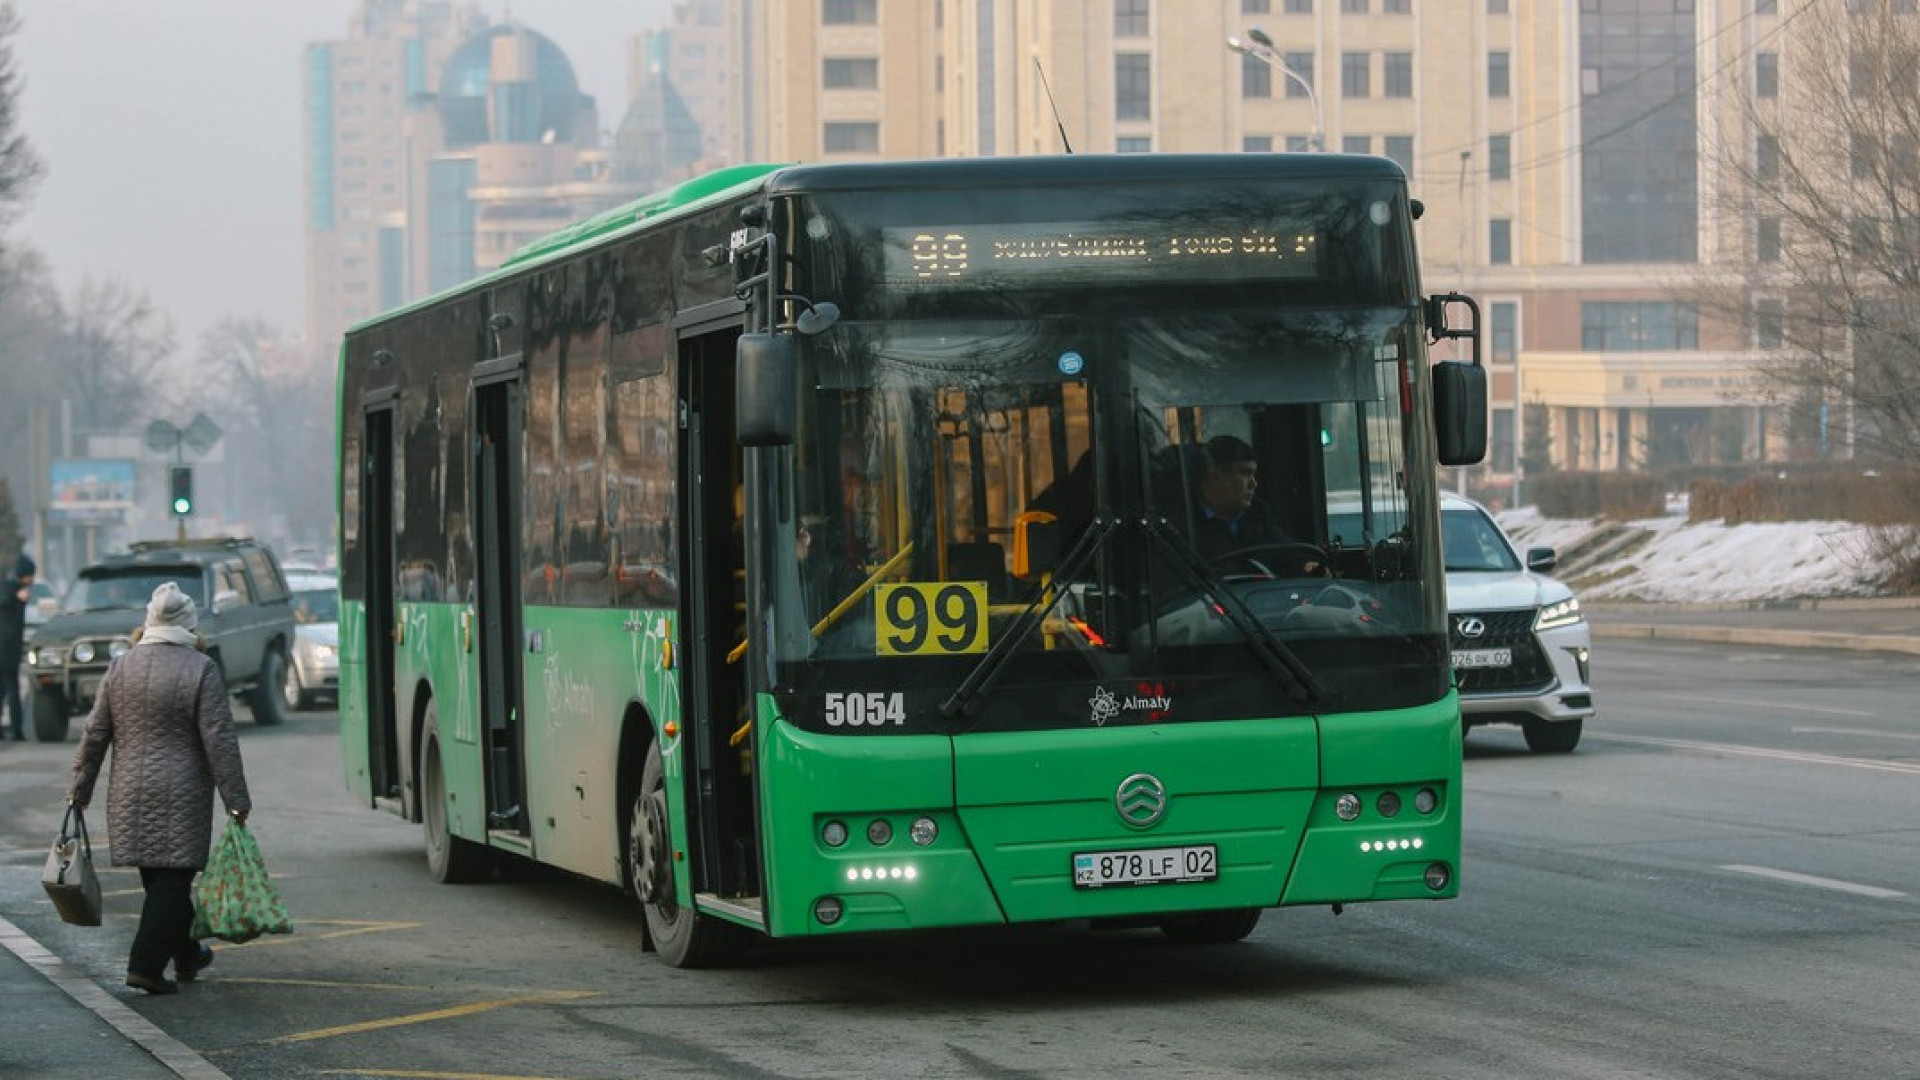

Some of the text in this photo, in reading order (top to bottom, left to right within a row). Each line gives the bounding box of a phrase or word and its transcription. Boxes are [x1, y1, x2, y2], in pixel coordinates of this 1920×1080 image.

[911, 234, 968, 277] 99
[885, 585, 978, 652] 99
[825, 692, 906, 726] 5054
[1122, 695, 1171, 711] Almaty
[1077, 870, 1095, 882] KZ
[1100, 850, 1213, 879] 878 LF 02
